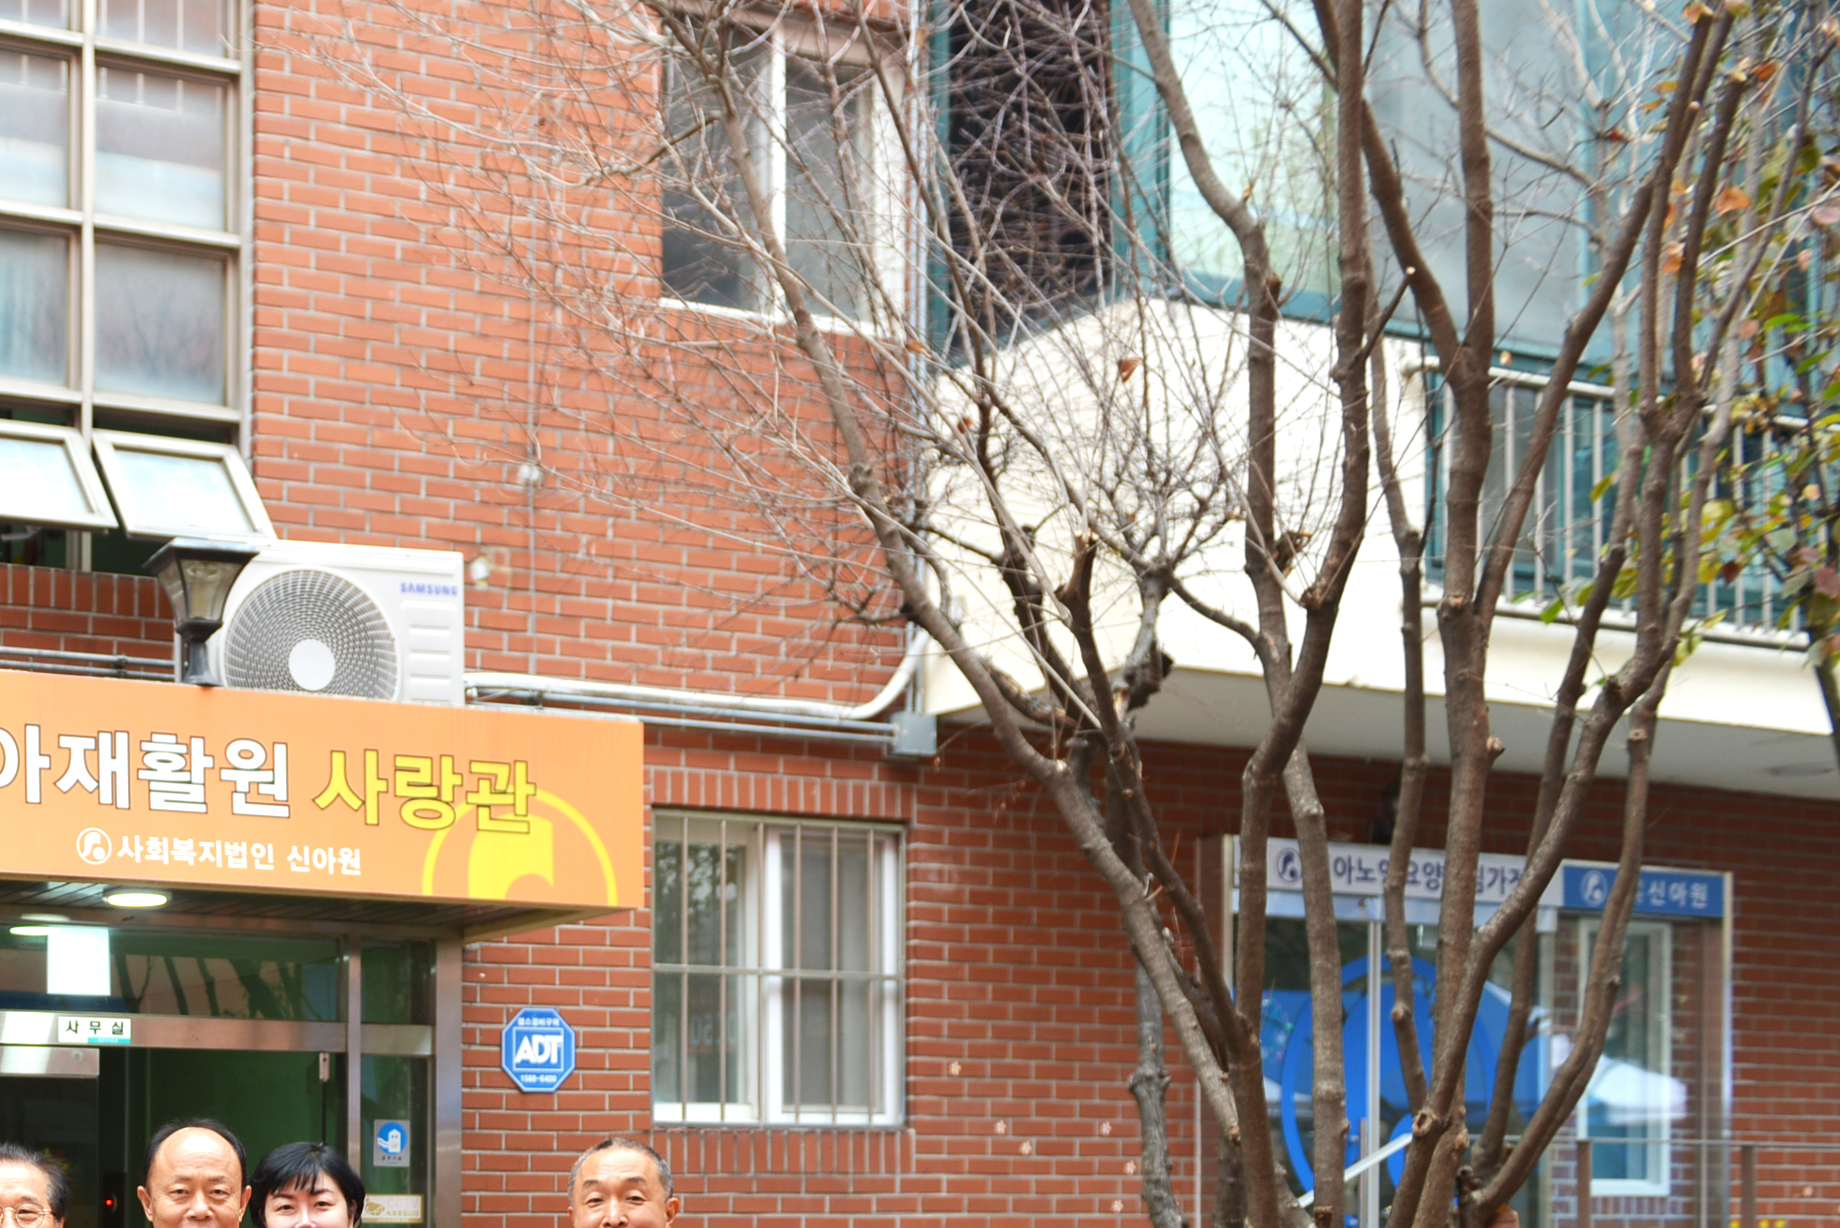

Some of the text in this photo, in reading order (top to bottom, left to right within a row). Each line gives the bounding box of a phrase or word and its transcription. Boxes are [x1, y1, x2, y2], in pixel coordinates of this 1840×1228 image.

[401, 582, 458, 595] SAMSUNG
[312, 745, 536, 836] 사랑관
[117, 836, 362, 877] 사회복지법인 신아원
[1648, 880, 1708, 909] 신아원
[514, 1034, 563, 1064] ADT
[387, 1198, 419, 1209] CCTV
